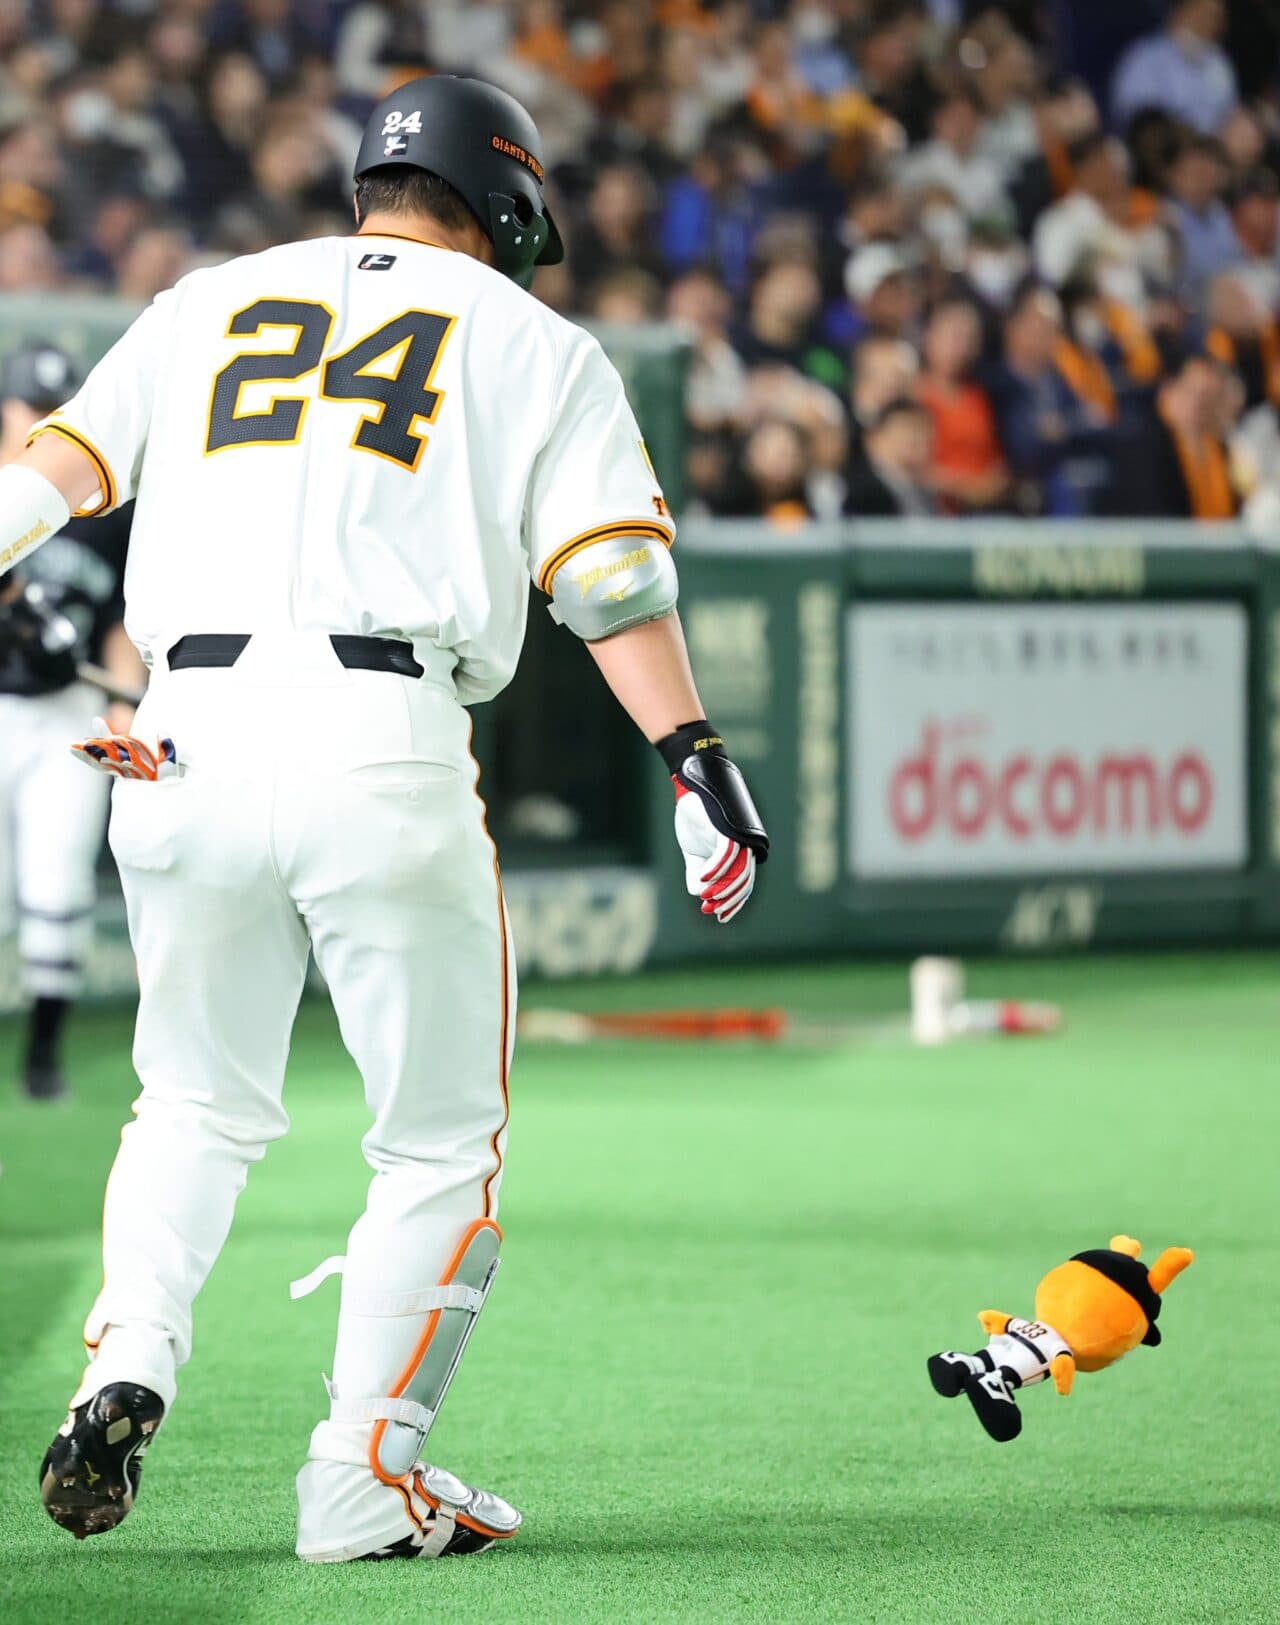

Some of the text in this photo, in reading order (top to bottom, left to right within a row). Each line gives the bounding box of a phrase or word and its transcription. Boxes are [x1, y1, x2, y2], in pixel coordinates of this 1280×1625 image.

[381, 110, 423, 136] 24
[491, 135, 527, 163] GIANTS
[202, 296, 458, 474] 24
[888, 714, 1214, 845] docomo
